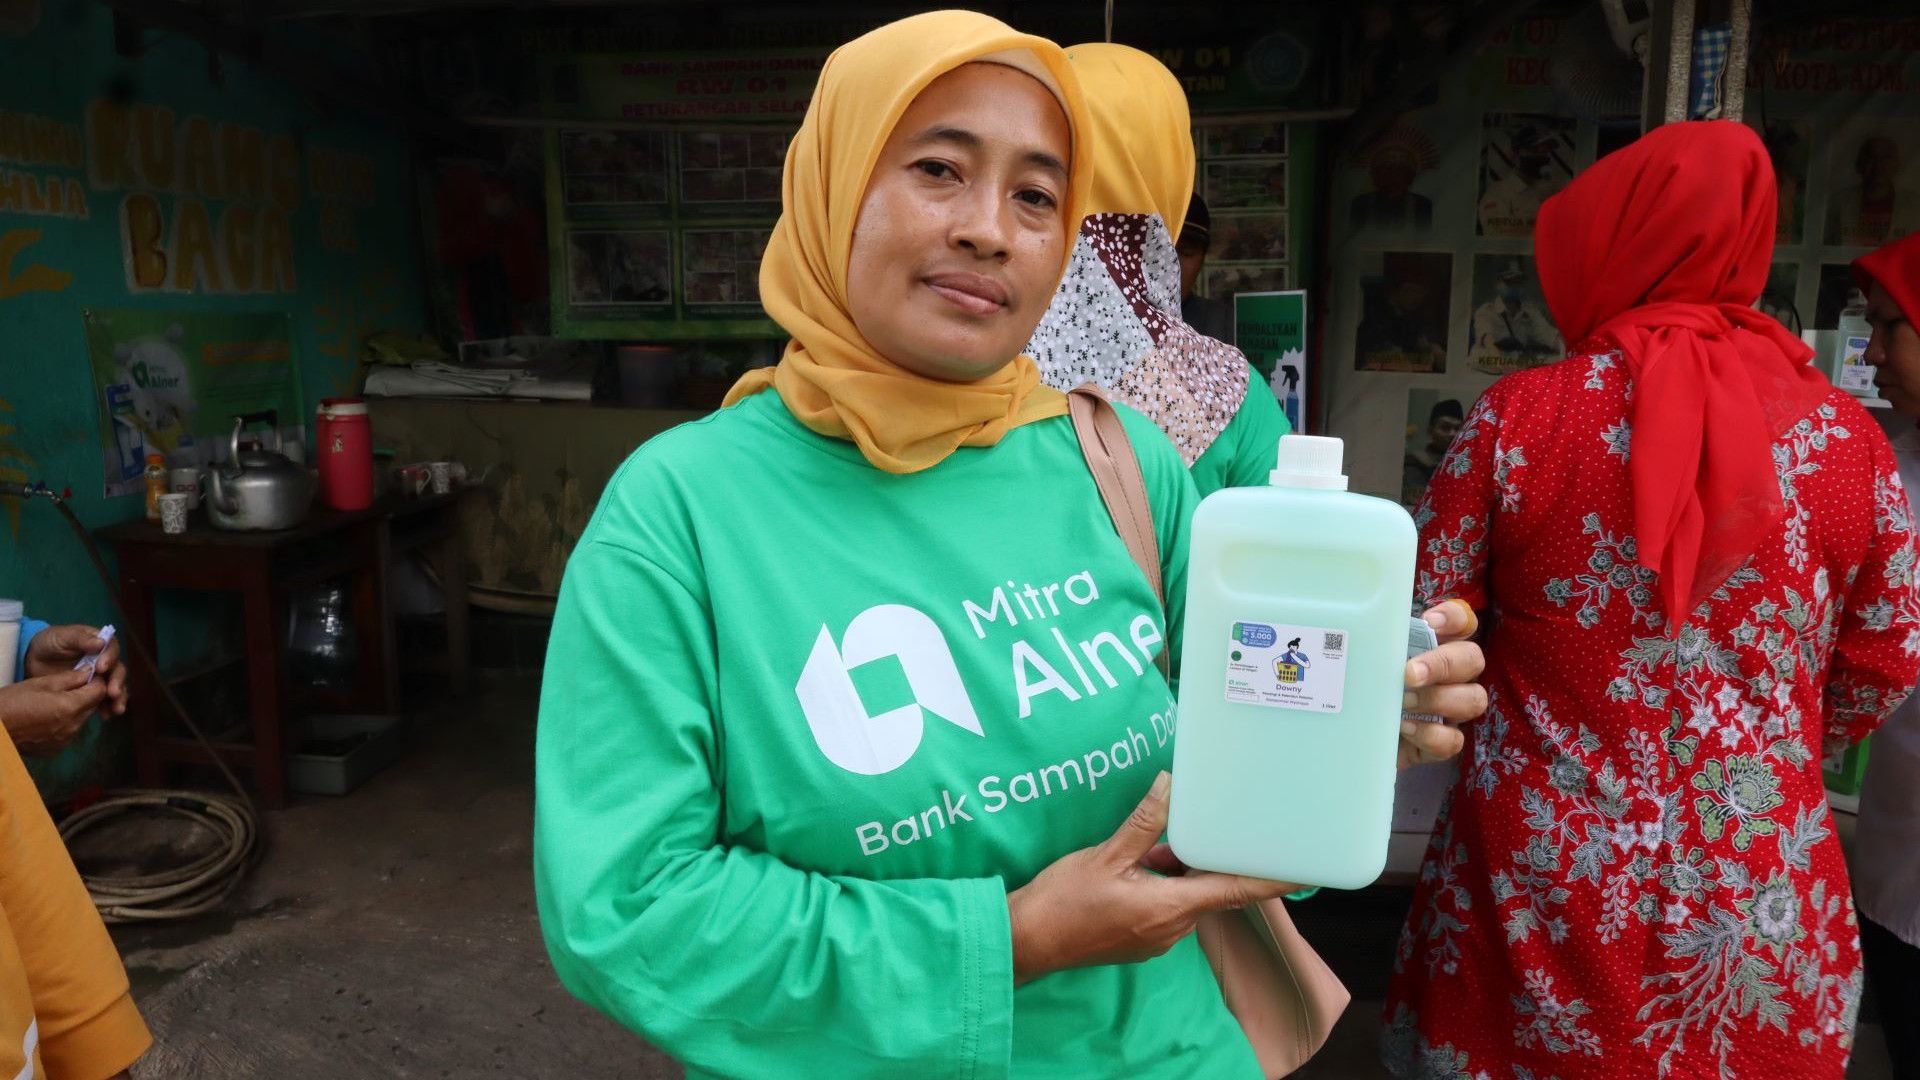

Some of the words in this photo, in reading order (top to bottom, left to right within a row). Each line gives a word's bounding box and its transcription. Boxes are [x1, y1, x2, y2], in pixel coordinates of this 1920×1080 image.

[675, 77, 736, 94] RW
[747, 77, 787, 93] 01
[961, 569, 1100, 640] Mitra
[1275, 683, 1303, 693] Downy
[854, 788, 975, 857] Bank
[976, 726, 1151, 814] Sampah
